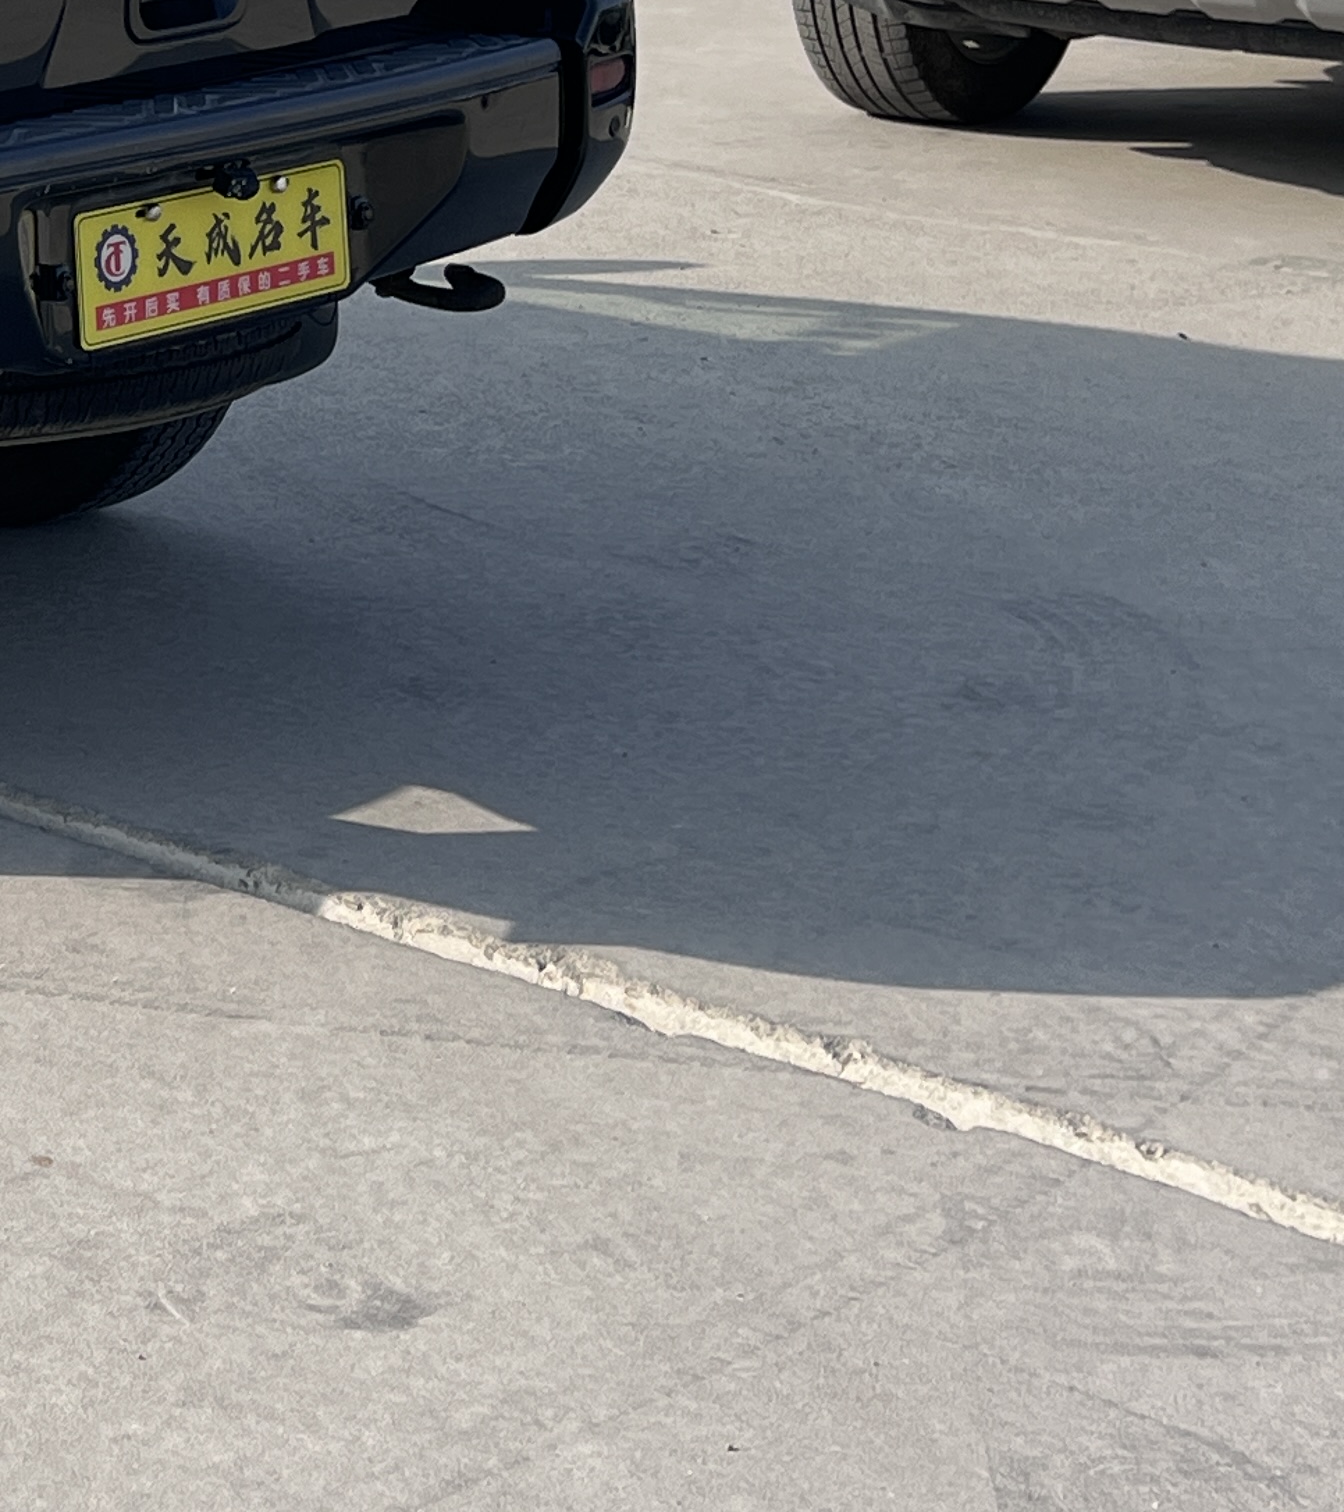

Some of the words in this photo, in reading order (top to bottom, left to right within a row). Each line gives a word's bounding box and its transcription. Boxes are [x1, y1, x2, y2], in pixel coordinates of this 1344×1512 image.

[155, 187, 331, 278] 天成名车
[101, 291, 181, 330] 先开后买
[196, 255, 330, 306] 有质保的二手车
